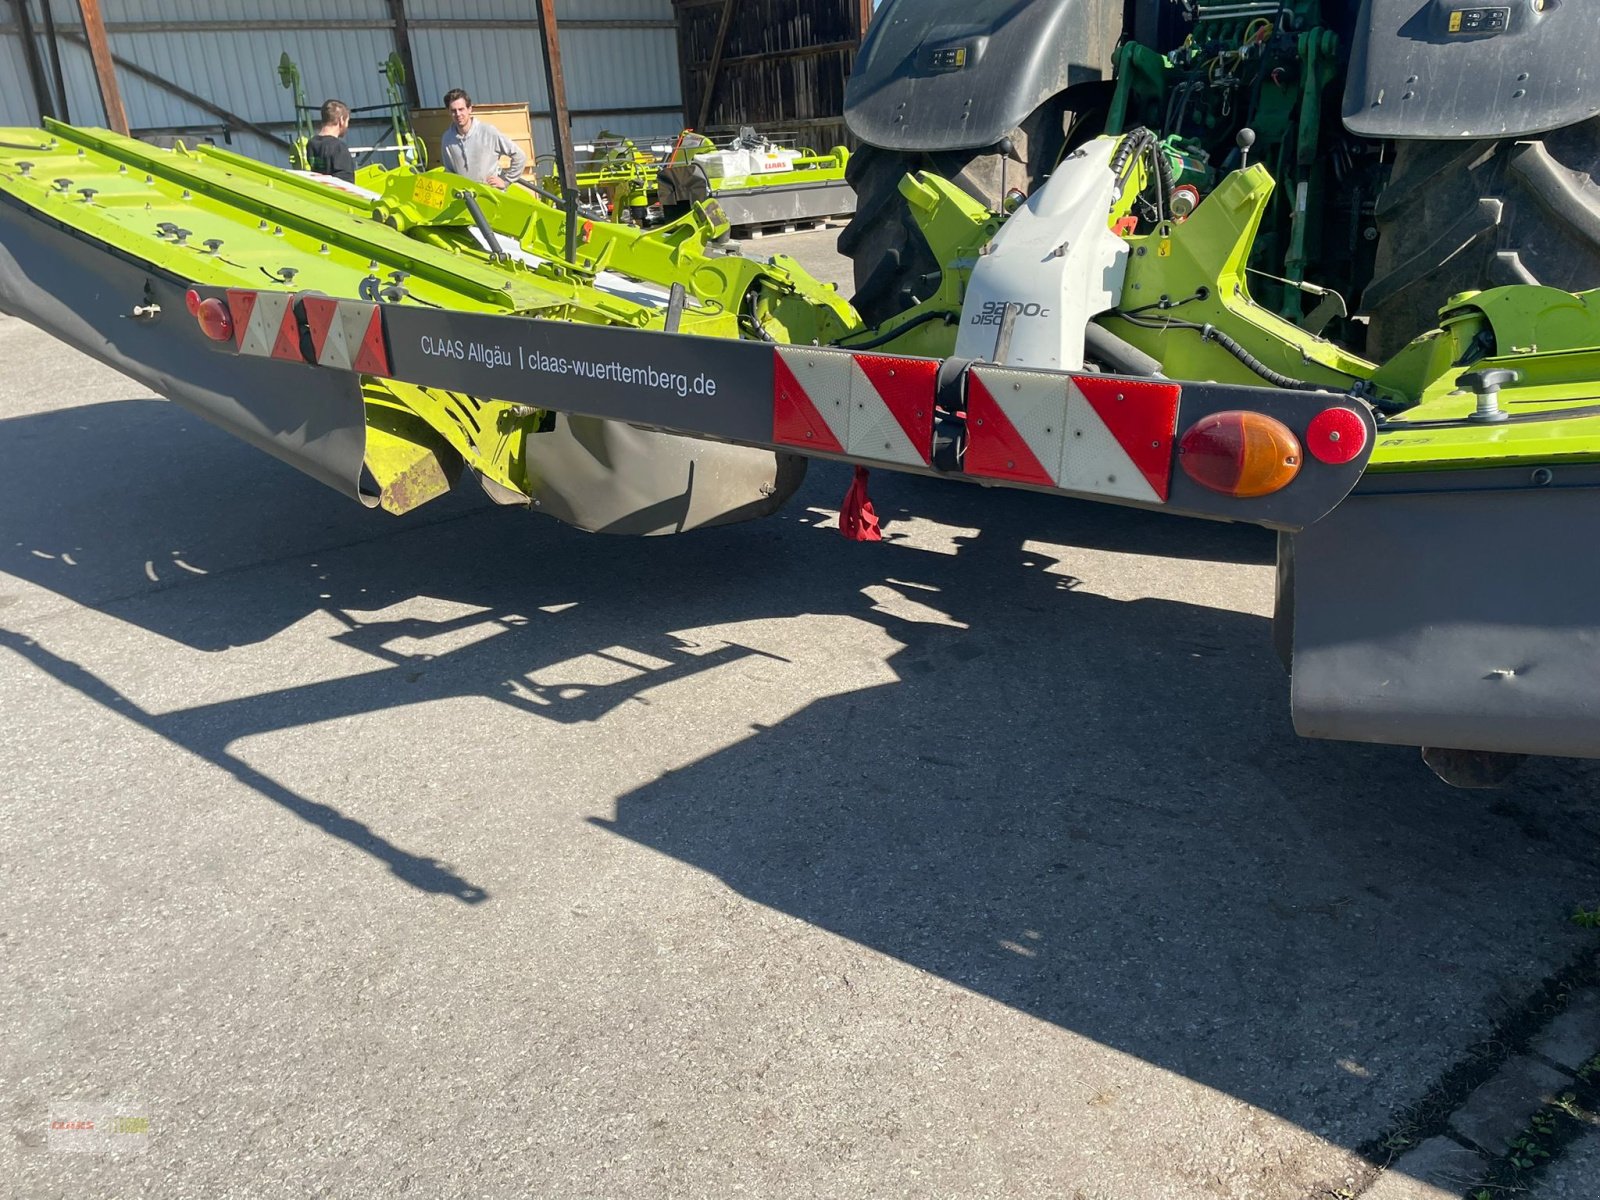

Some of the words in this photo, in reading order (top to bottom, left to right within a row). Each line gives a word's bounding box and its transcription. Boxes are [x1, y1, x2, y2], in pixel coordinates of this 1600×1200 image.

[971, 314, 1003, 325] DISC
[421, 335, 464, 360] CLAAS
[468, 342, 511, 368] Allgäu
[528, 351, 716, 396] claas-wuerttemberg.de
